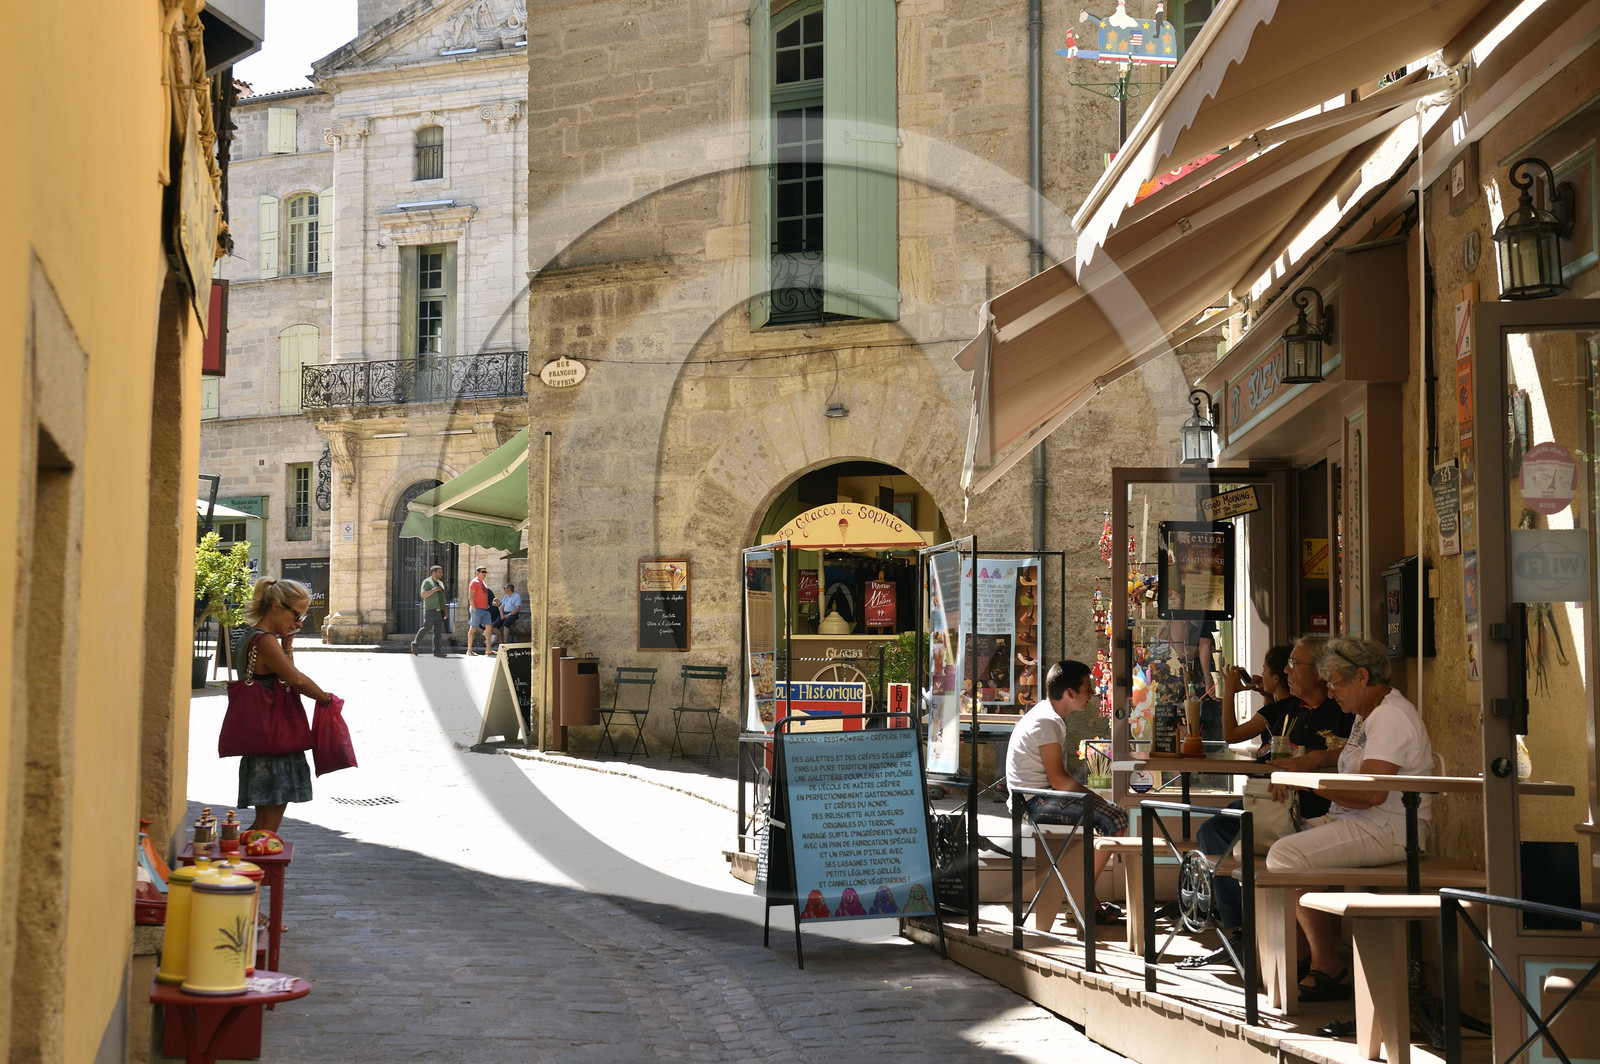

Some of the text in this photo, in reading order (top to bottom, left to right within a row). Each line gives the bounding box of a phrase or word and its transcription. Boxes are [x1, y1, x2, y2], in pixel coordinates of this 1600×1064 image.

[1464, 236, 1475, 268] 14
[548, 378, 576, 386] OUSTRIN
[1204, 500, 1220, 510] GOOD
[795, 506, 836, 539] Glaces
[840, 504, 852, 516] de
[858, 506, 903, 533] Sophie
[1180, 532, 1224, 544] Kerisa
[1307, 541, 1312, 551] R
[1388, 623, 1399, 634] POST
[776, 684, 864, 702] our Historique
[871, 733, 898, 741] CRÊPERIE
[805, 754, 834, 763] GALETTES
[858, 752, 880, 760] CRÊPES
[882, 750, 912, 759] RÉALISÉES
[808, 774, 843, 782] GALETTIÈRE
[844, 772, 882, 780] DOUBLEMENT
[885, 770, 913, 778] DIPLÔMÉE
[818, 783, 841, 791] L'ÉCOLE
[853, 781, 875, 789] MAÎTRE
[877, 780, 900, 788] CRÊPIER
[806, 792, 862, 801] PERFECTIONNEMENT
[865, 789, 915, 798] GASTRONOMIQUE
[825, 811, 863, 820] BRUSCHETTE
[878, 809, 904, 817] SAVEURS
[823, 821, 856, 830] ORIGINALES
[802, 827, 917, 840] MARIAGE SUBTIL D'INGRÉDIENTS NOBLES
[852, 838, 888, 847] FABRICATION
[838, 859, 867, 867] LASAGNES
[848, 868, 875, 876] LÉGUMES
[828, 878, 867, 887] CANNELLONIS
[869, 876, 906, 885] VÉGÉTARIENS
